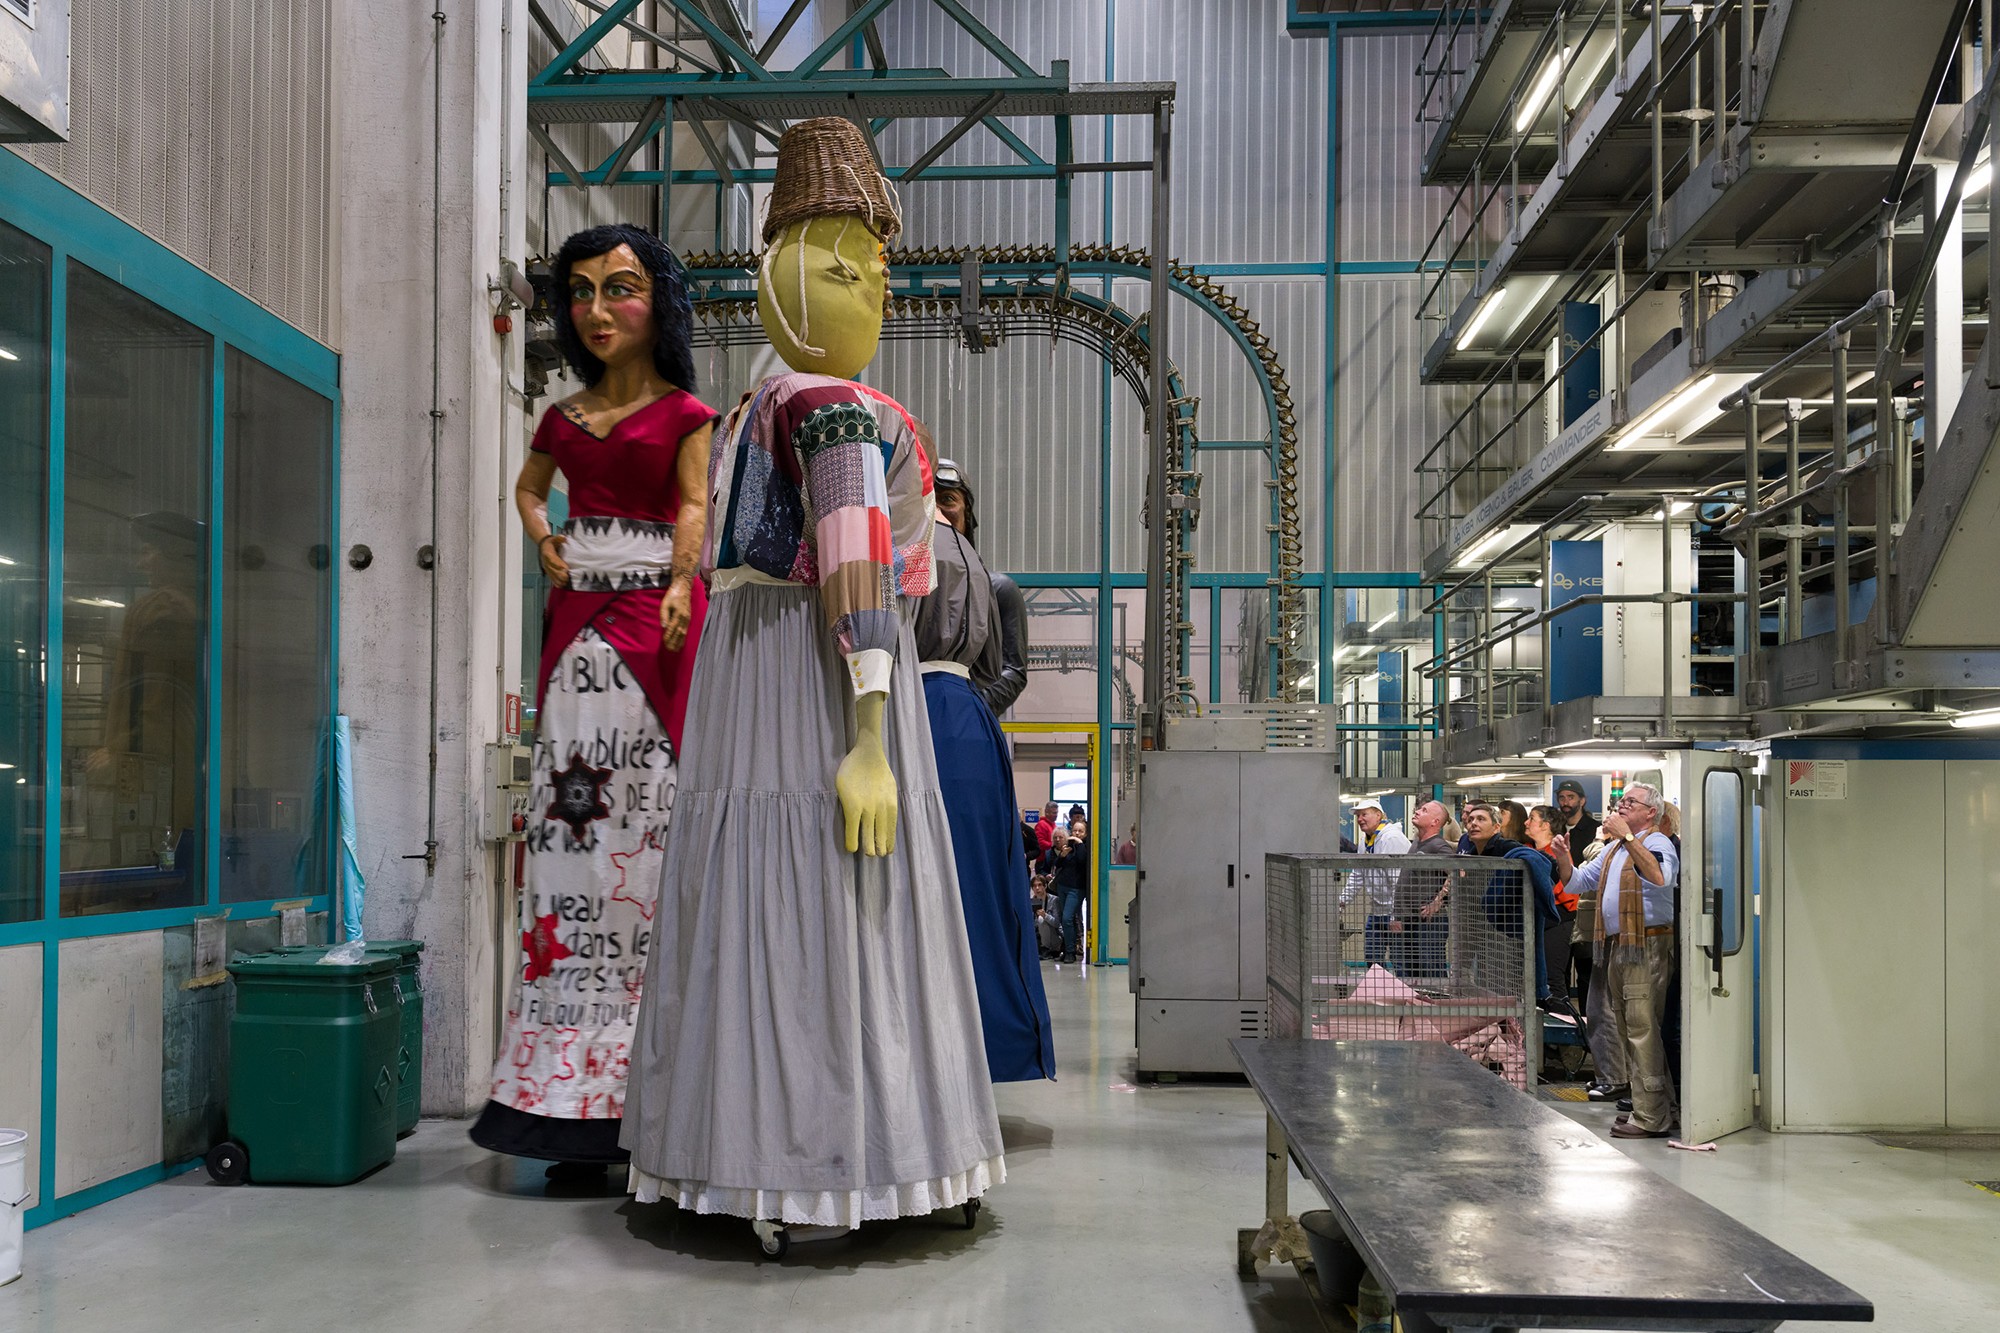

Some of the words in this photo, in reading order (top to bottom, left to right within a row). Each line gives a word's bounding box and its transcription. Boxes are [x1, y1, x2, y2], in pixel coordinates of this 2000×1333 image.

[1507, 468, 1534, 499] BAUER
[1540, 411, 1603, 473] COMMANDER
[626, 783, 650, 812] DE
[1789, 789, 1815, 797] FAIST
[563, 926, 622, 960] dans
